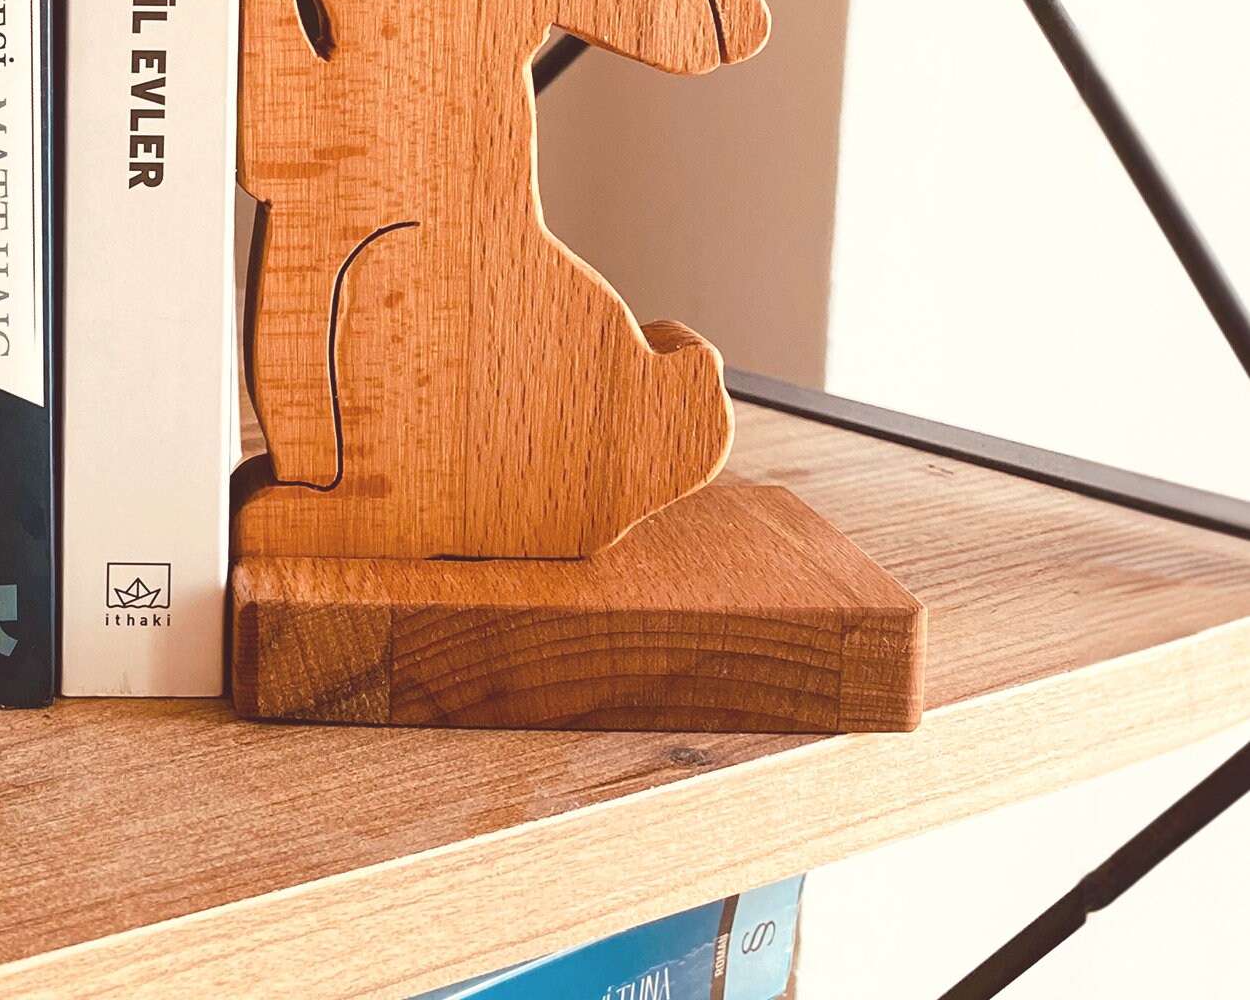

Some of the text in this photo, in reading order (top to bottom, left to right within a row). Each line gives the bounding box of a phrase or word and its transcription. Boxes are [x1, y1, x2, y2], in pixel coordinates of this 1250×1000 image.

[127, 49, 168, 190] EVLER
[104, 612, 172, 627] ithaki
[714, 932, 729, 978] ROMAN
